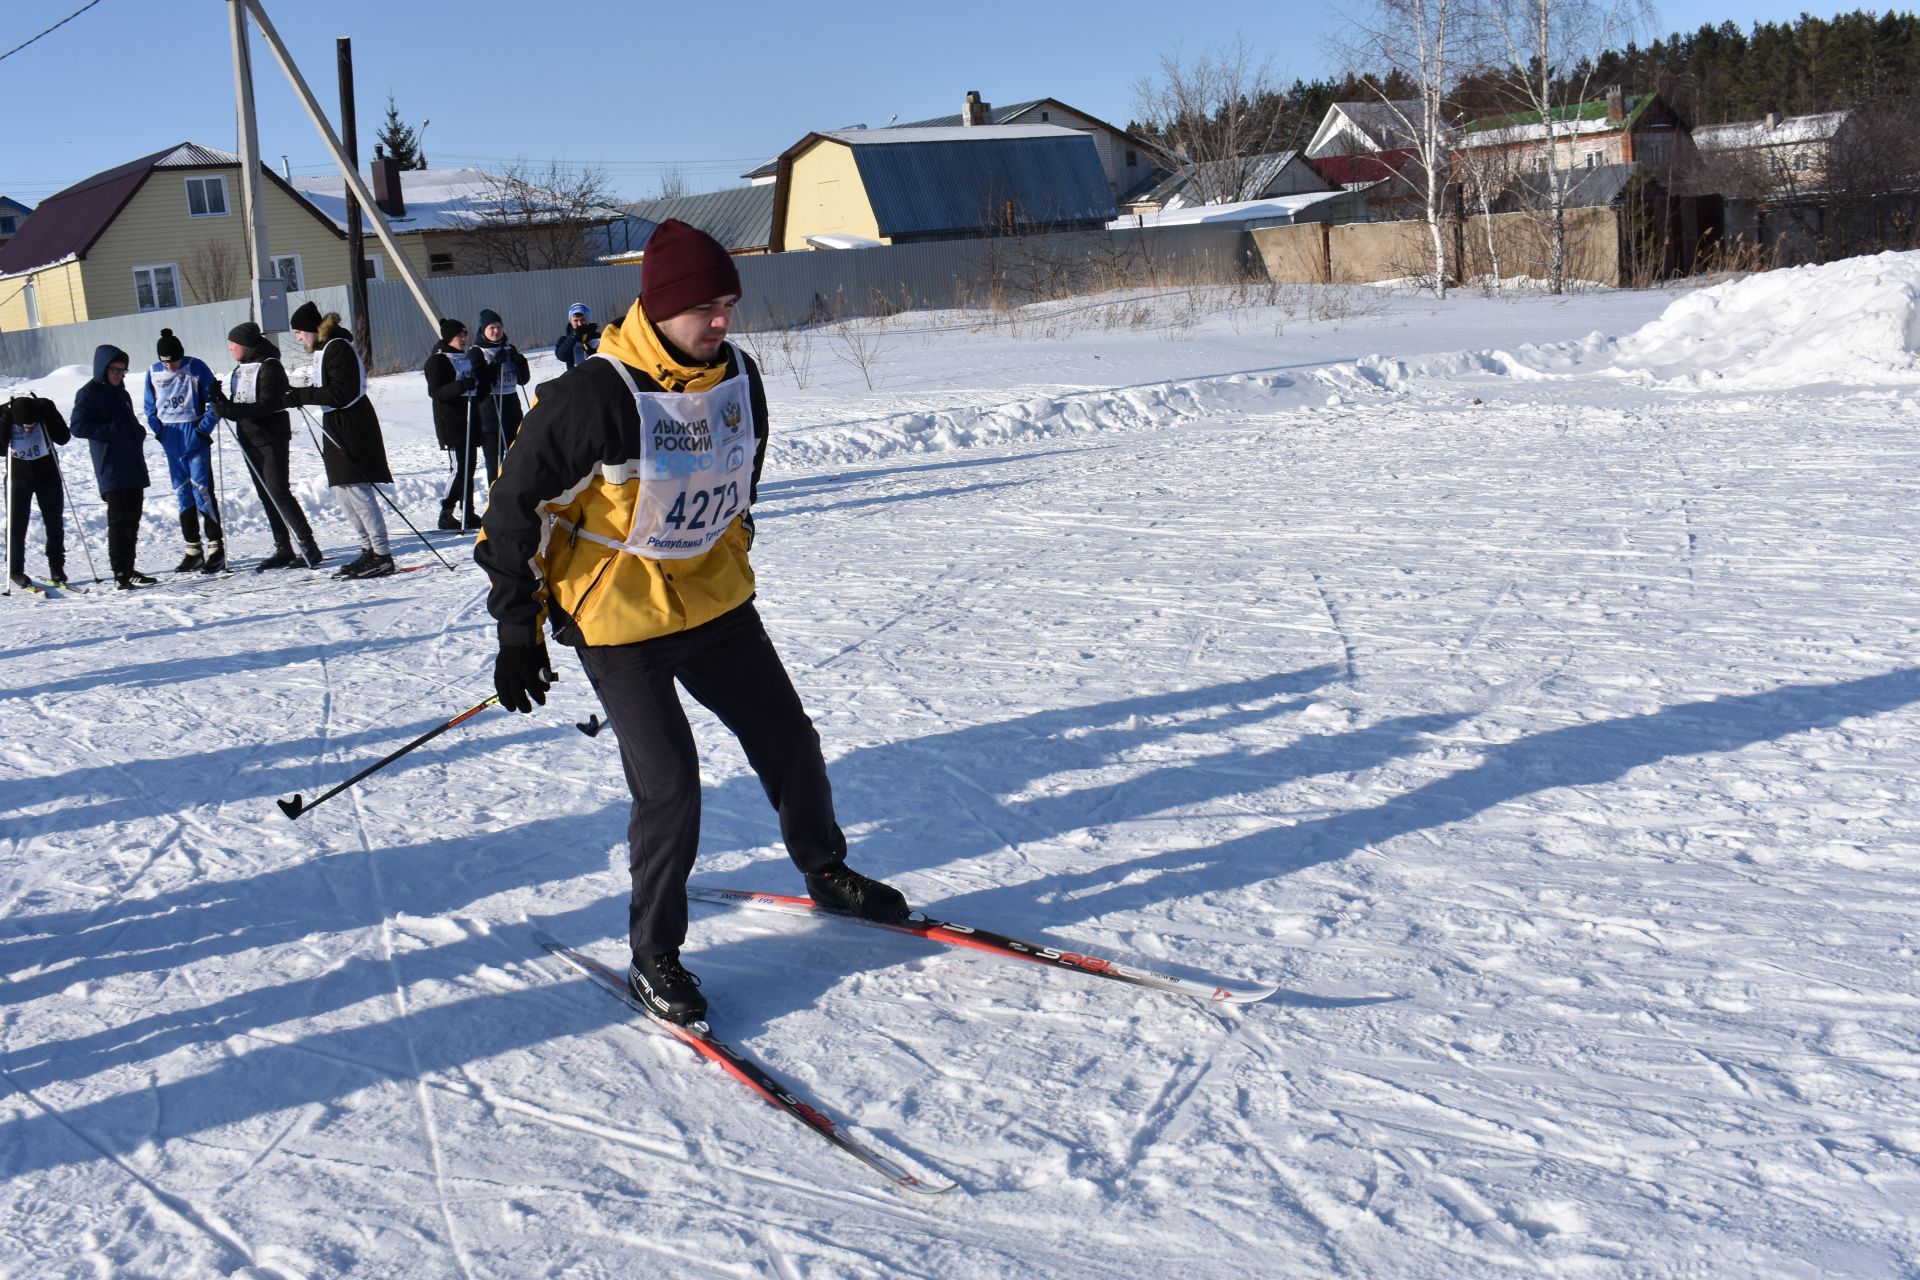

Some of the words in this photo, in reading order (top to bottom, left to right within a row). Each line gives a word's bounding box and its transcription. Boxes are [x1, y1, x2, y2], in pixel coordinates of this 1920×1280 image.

[652, 419, 710, 435] ЛЫЖНЯ
[655, 435, 713, 452] РОССИИ
[655, 451, 714, 474] 2020
[665, 480, 739, 530] 4272
[646, 536, 703, 549] Республика
[631, 962, 671, 1013] SPINE
